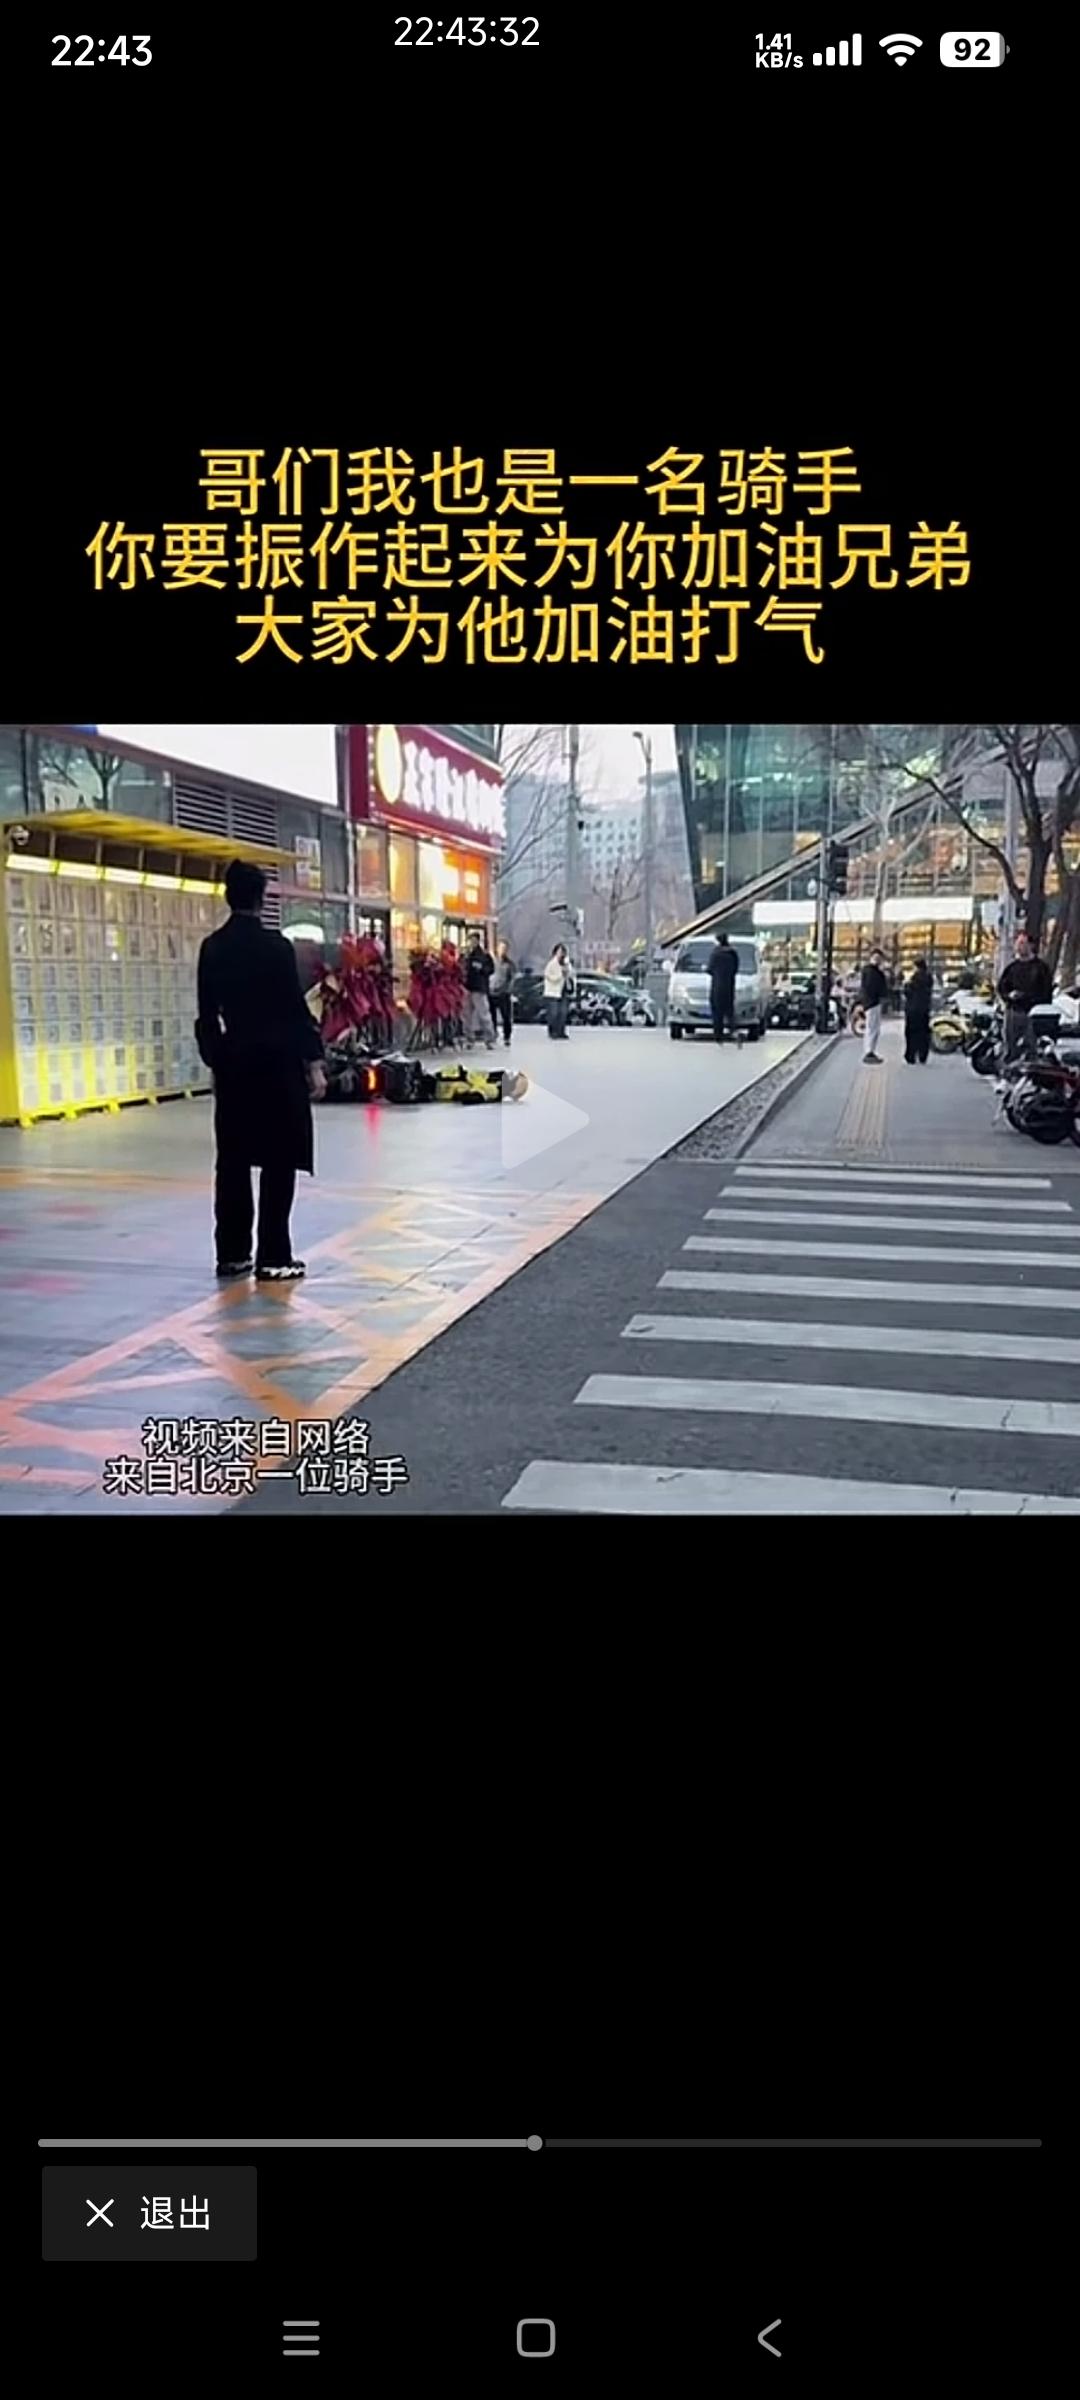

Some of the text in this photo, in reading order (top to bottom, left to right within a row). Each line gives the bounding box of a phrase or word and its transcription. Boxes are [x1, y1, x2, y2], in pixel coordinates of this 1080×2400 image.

[395, 17, 540, 46] 22:43:32
[755, 33, 792, 50] 1.41
[52, 35, 152, 66] 22:43
[755, 52, 804, 69] KB/s
[954, 39, 991, 61] 92
[141, 2195, 210, 2230] 退出
